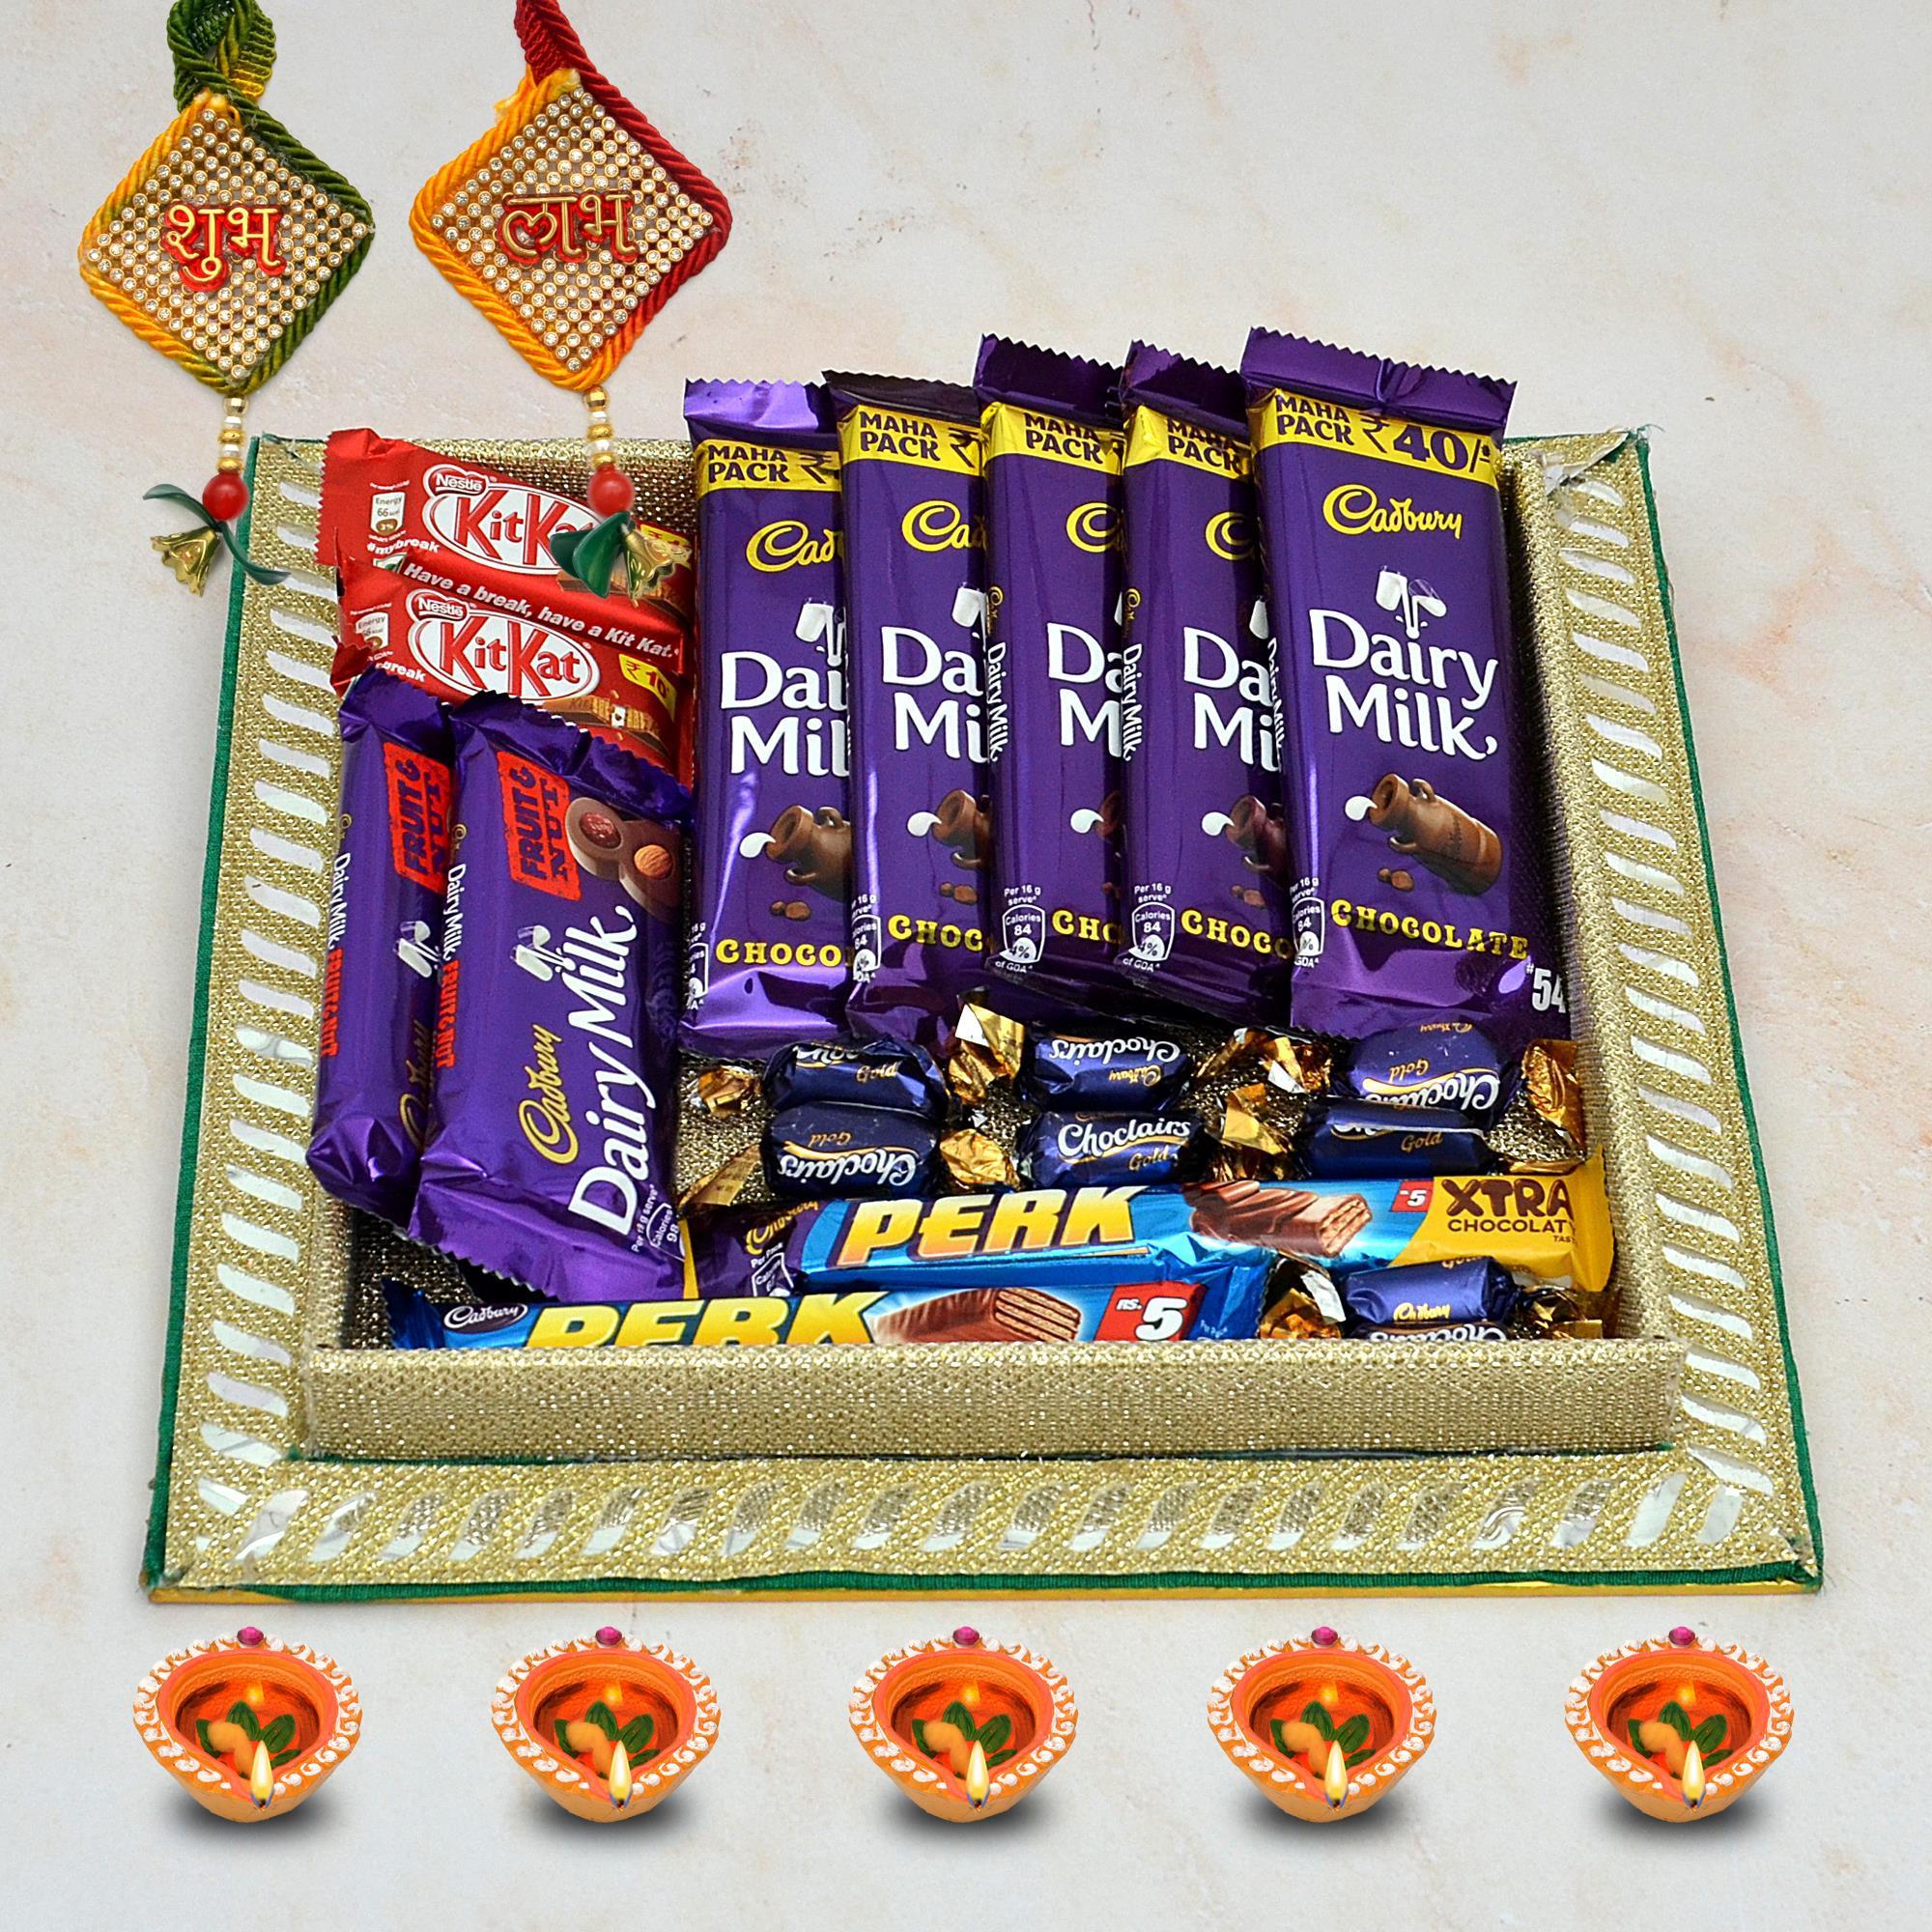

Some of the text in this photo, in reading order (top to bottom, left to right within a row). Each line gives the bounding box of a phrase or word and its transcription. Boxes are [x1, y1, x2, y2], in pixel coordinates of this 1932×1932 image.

[164, 201, 281, 285] शुभ
[499, 194, 638, 261] लाभ
[860, 410, 938, 440] MAHA
[1023, 412, 1102, 442] MAHA
[1275, 394, 1350, 423] MAHA
[859, 431, 942, 462] PACK
[1025, 431, 1104, 466] PACK
[1276, 413, 1355, 446] PACK
[707, 443, 788, 463] MAHA
[707, 461, 790, 484] PACK
[1167, 435, 1244, 475] PACK
[1322, 483, 1463, 539] Cadbury
[404, 562, 454, 590] Have
[456, 582, 470, 597] a
[474, 586, 533, 620] break,
[537, 606, 583, 633] have
[589, 624, 601, 638] a
[603, 626, 637, 650] Kit
[440, 617, 582, 698] KitKat
[986, 641, 1007, 705] Dairy
[1122, 642, 1143, 705] Dairy
[1308, 609, 1499, 711] Dairy
[721, 651, 848, 711] Dai
[987, 702, 1009, 762] Milk
[1122, 702, 1143, 762] Milk
[1324, 674, 1498, 760] Milk
[730, 715, 850, 777] Mil
[398, 783, 428, 875] FRUIT
[511, 789, 549, 881] FRUIT
[541, 777, 571, 884] NUT
[331, 853, 352, 906] Dairy
[443, 864, 467, 916] Dairy
[1005, 884, 1041, 897] Per 16 g
[1134, 882, 1172, 895] Per 16 g
[327, 901, 348, 951] Milk
[442, 912, 464, 962] Milk
[1005, 913, 1041, 926] Calories
[1013, 923, 1033, 937] 84
[1135, 910, 1171, 923] Calories
[1143, 921, 1162, 934] 84
[1330, 898, 1529, 960] CHOCOLATE
[564, 905, 658, 1236] Dairy Milk
[1049, 1035, 1180, 1066] Choclairs
[1388, 1058, 1432, 1084] Gold
[518, 1024, 579, 1165] Cadbury
[809, 1131, 852, 1149] Gold
[1057, 1118, 1191, 1158] Choclairs
[1401, 1130, 1444, 1154] Gold
[778, 1148, 920, 1187] Choclairs
[1441, 1179, 1575, 1220] XTRA
[631, 1235, 644, 1253] Per
[652, 1209, 673, 1247] Calories
[666, 1223, 680, 1243] 98
[835, 1185, 1150, 1267] PERK
[443, 1302, 527, 1329] Cadbury
[1134, 1295, 1188, 1341] 5
